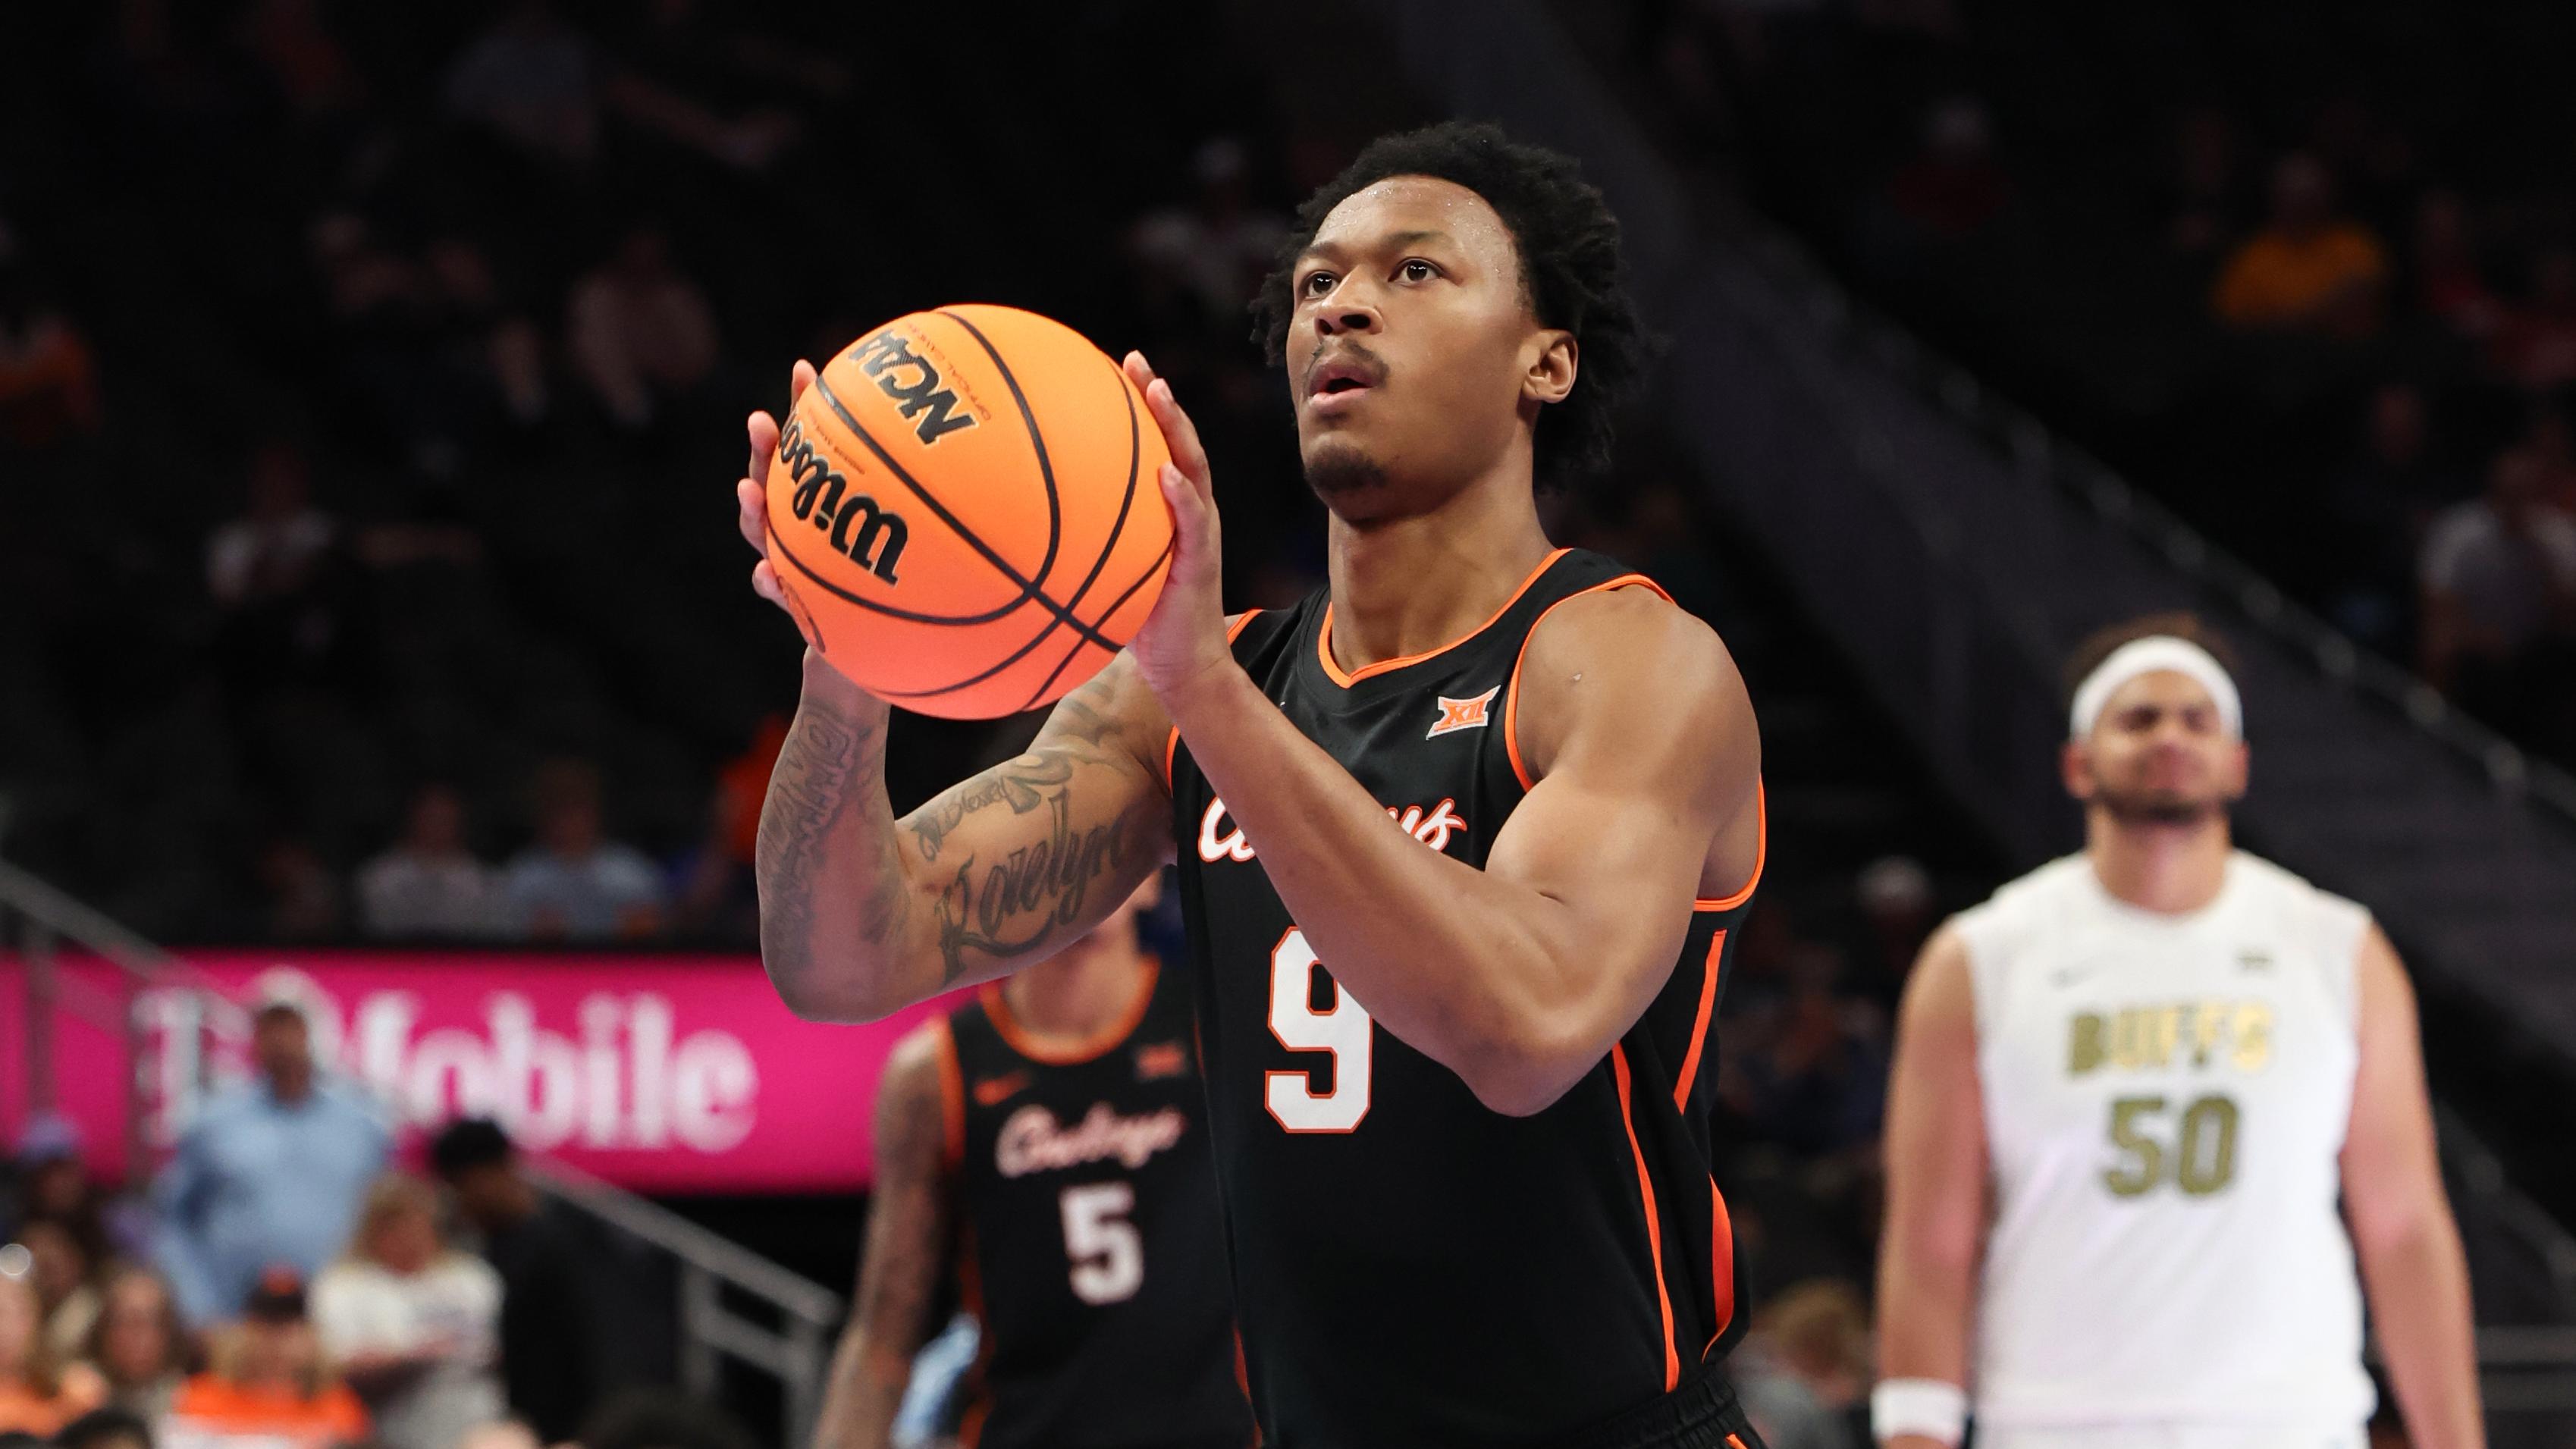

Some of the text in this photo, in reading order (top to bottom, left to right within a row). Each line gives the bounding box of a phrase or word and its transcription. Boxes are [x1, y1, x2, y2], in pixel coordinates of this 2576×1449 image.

[848, 327, 980, 447] NCAA
[1265, 926, 1373, 1134] 9
[2068, 1001, 2271, 1078] BUFFS
[2101, 1094, 2240, 1198] 50
[1059, 1181, 1144, 1306] 5
